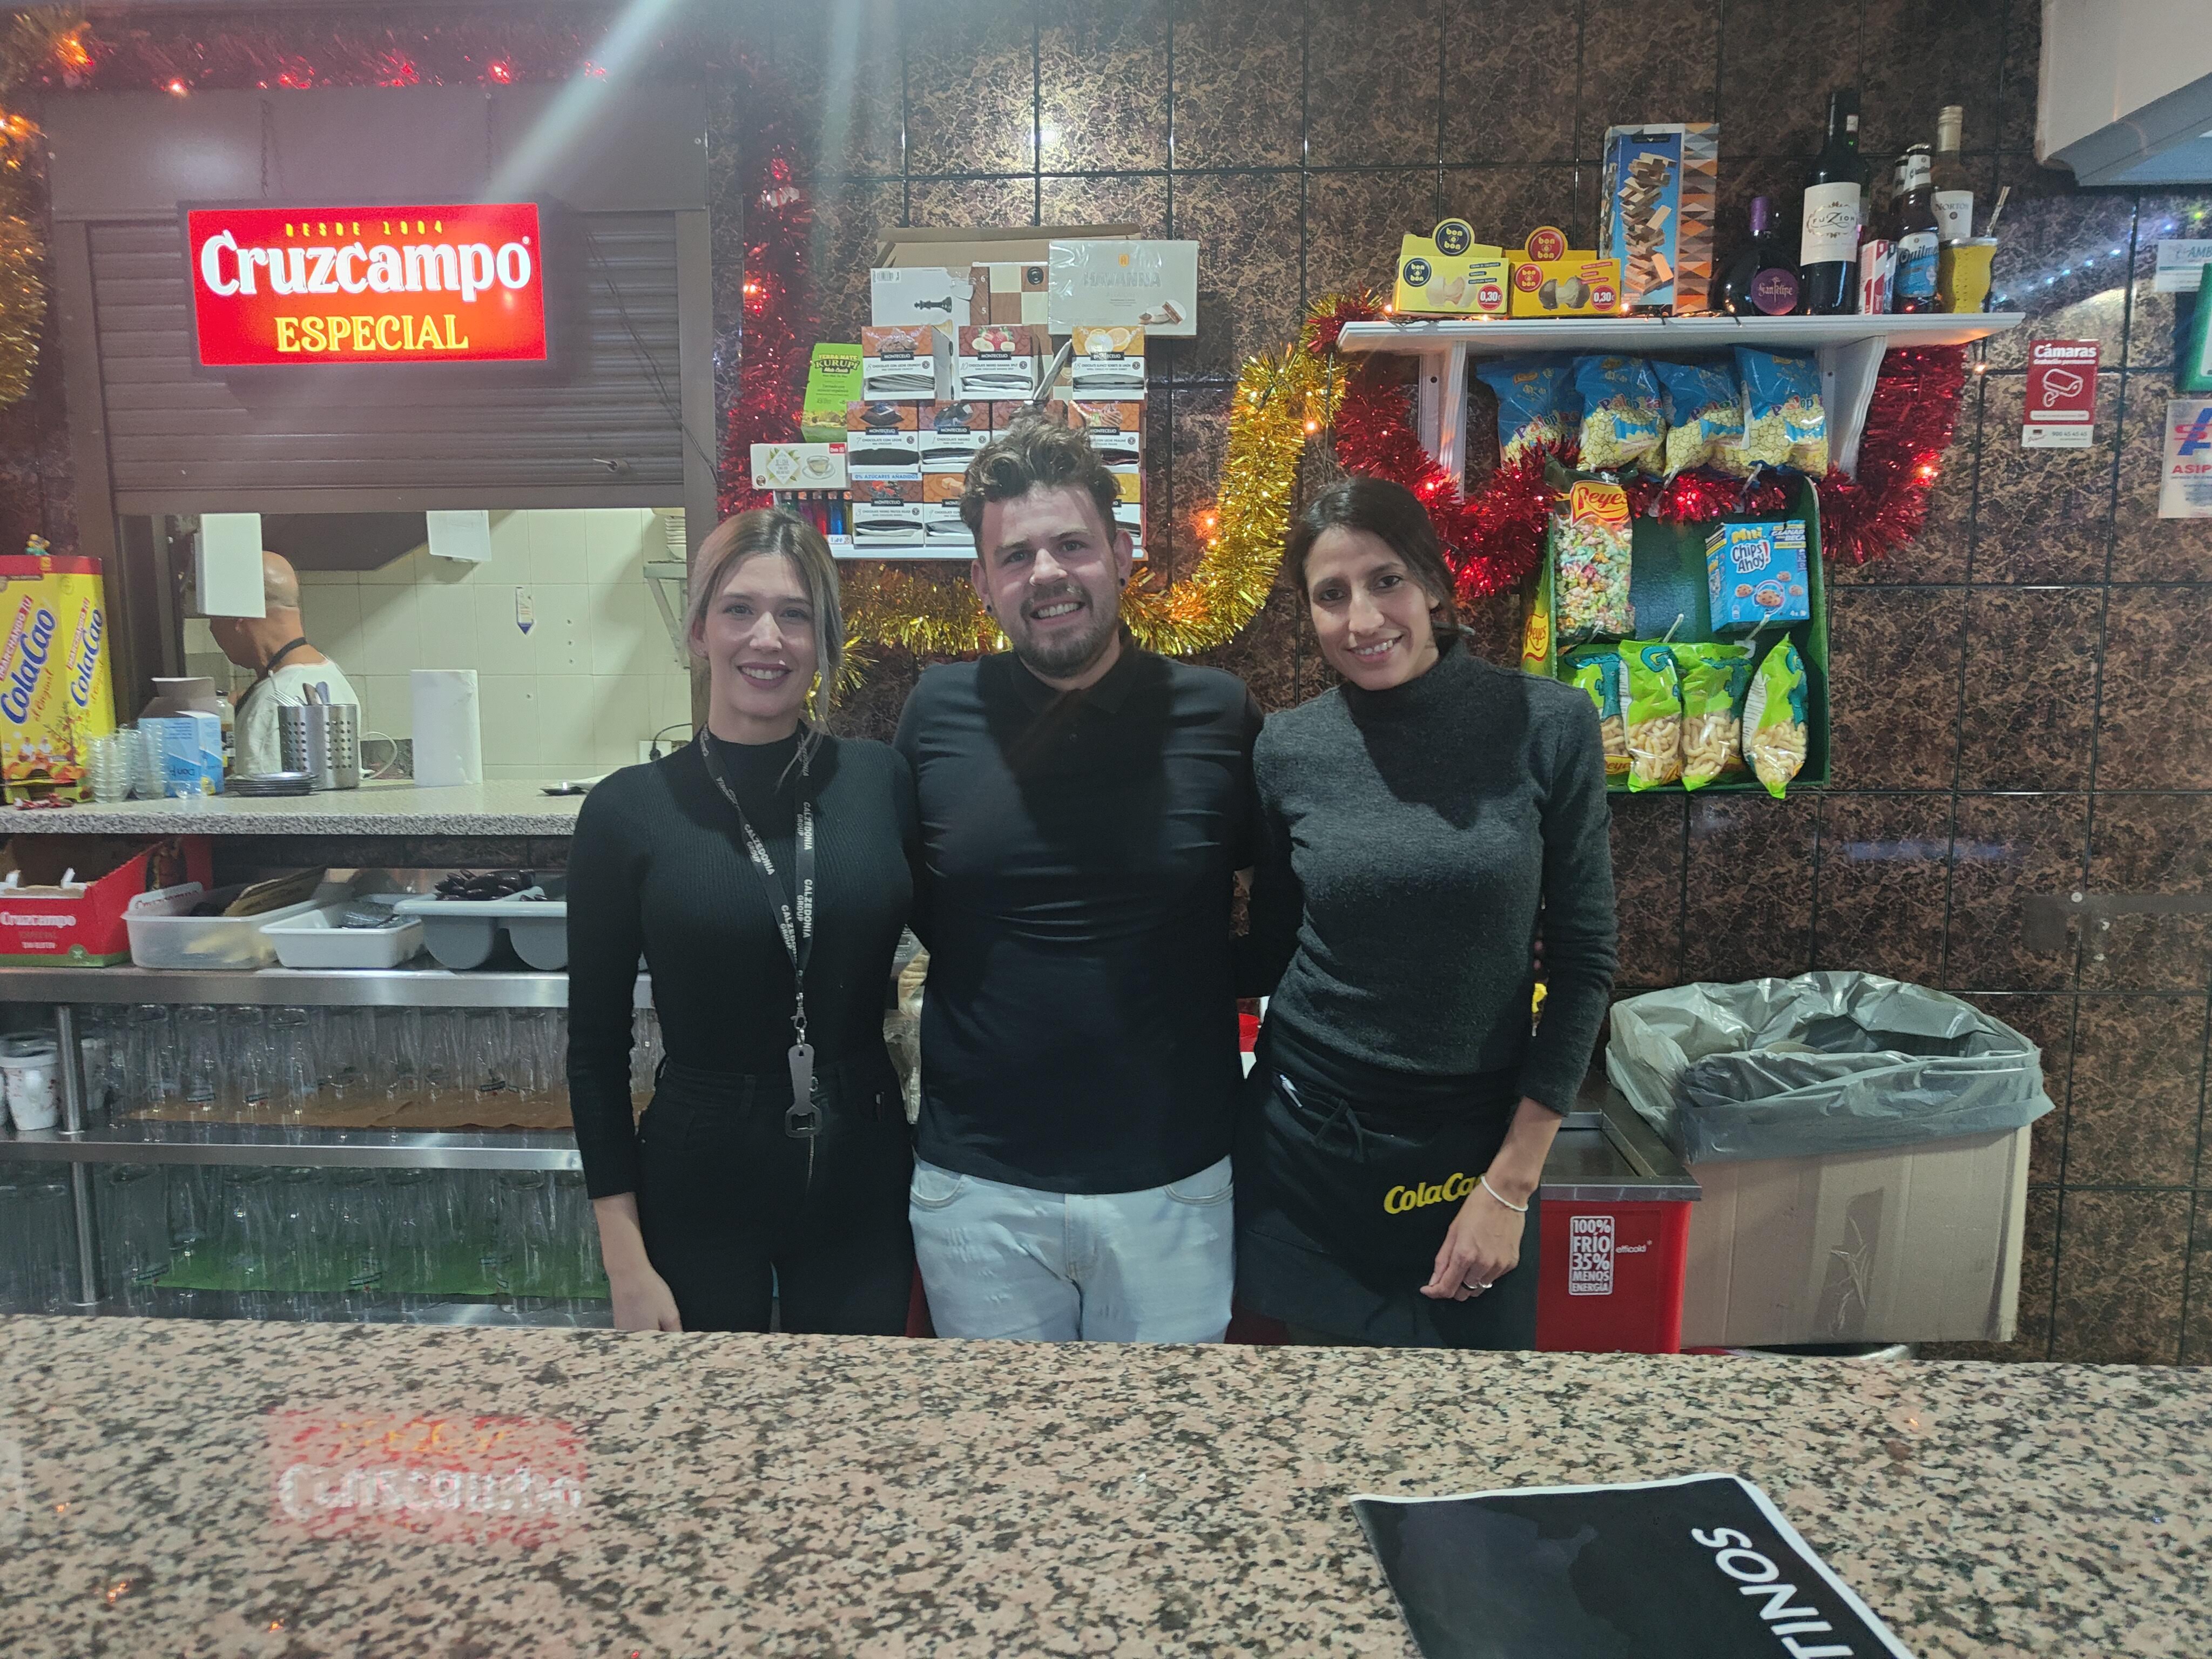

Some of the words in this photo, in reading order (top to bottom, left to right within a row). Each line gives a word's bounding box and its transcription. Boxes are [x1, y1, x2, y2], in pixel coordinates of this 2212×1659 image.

[285, 222, 361, 237] DESDE
[382, 220, 443, 235] 1904
[1446, 228, 1463, 236] bon
[1444, 241, 1461, 249] bon
[201, 229, 531, 302] Cruzcampo
[276, 314, 469, 352] ESPECIAL
[2034, 343, 2096, 358] Cámaras
[1732, 544, 1763, 562] Chips
[1, 608, 56, 724] ColaCao
[71, 608, 102, 708] ColaCao
[801, 801, 813, 851] CALZEDONIA
[744, 824, 775, 875] CALZEDONIA
[746, 841, 761, 864] GROUP
[802, 879, 813, 938] CALZEDONIA
[1573, 1219, 1611, 1233] 100%
[1573, 1232, 1611, 1253] FRÍO
[1572, 1253, 1610, 1270] 35%
[1572, 1271, 1610, 1282] MENOS
[1572, 1282, 1608, 1292] ENERGÍA
